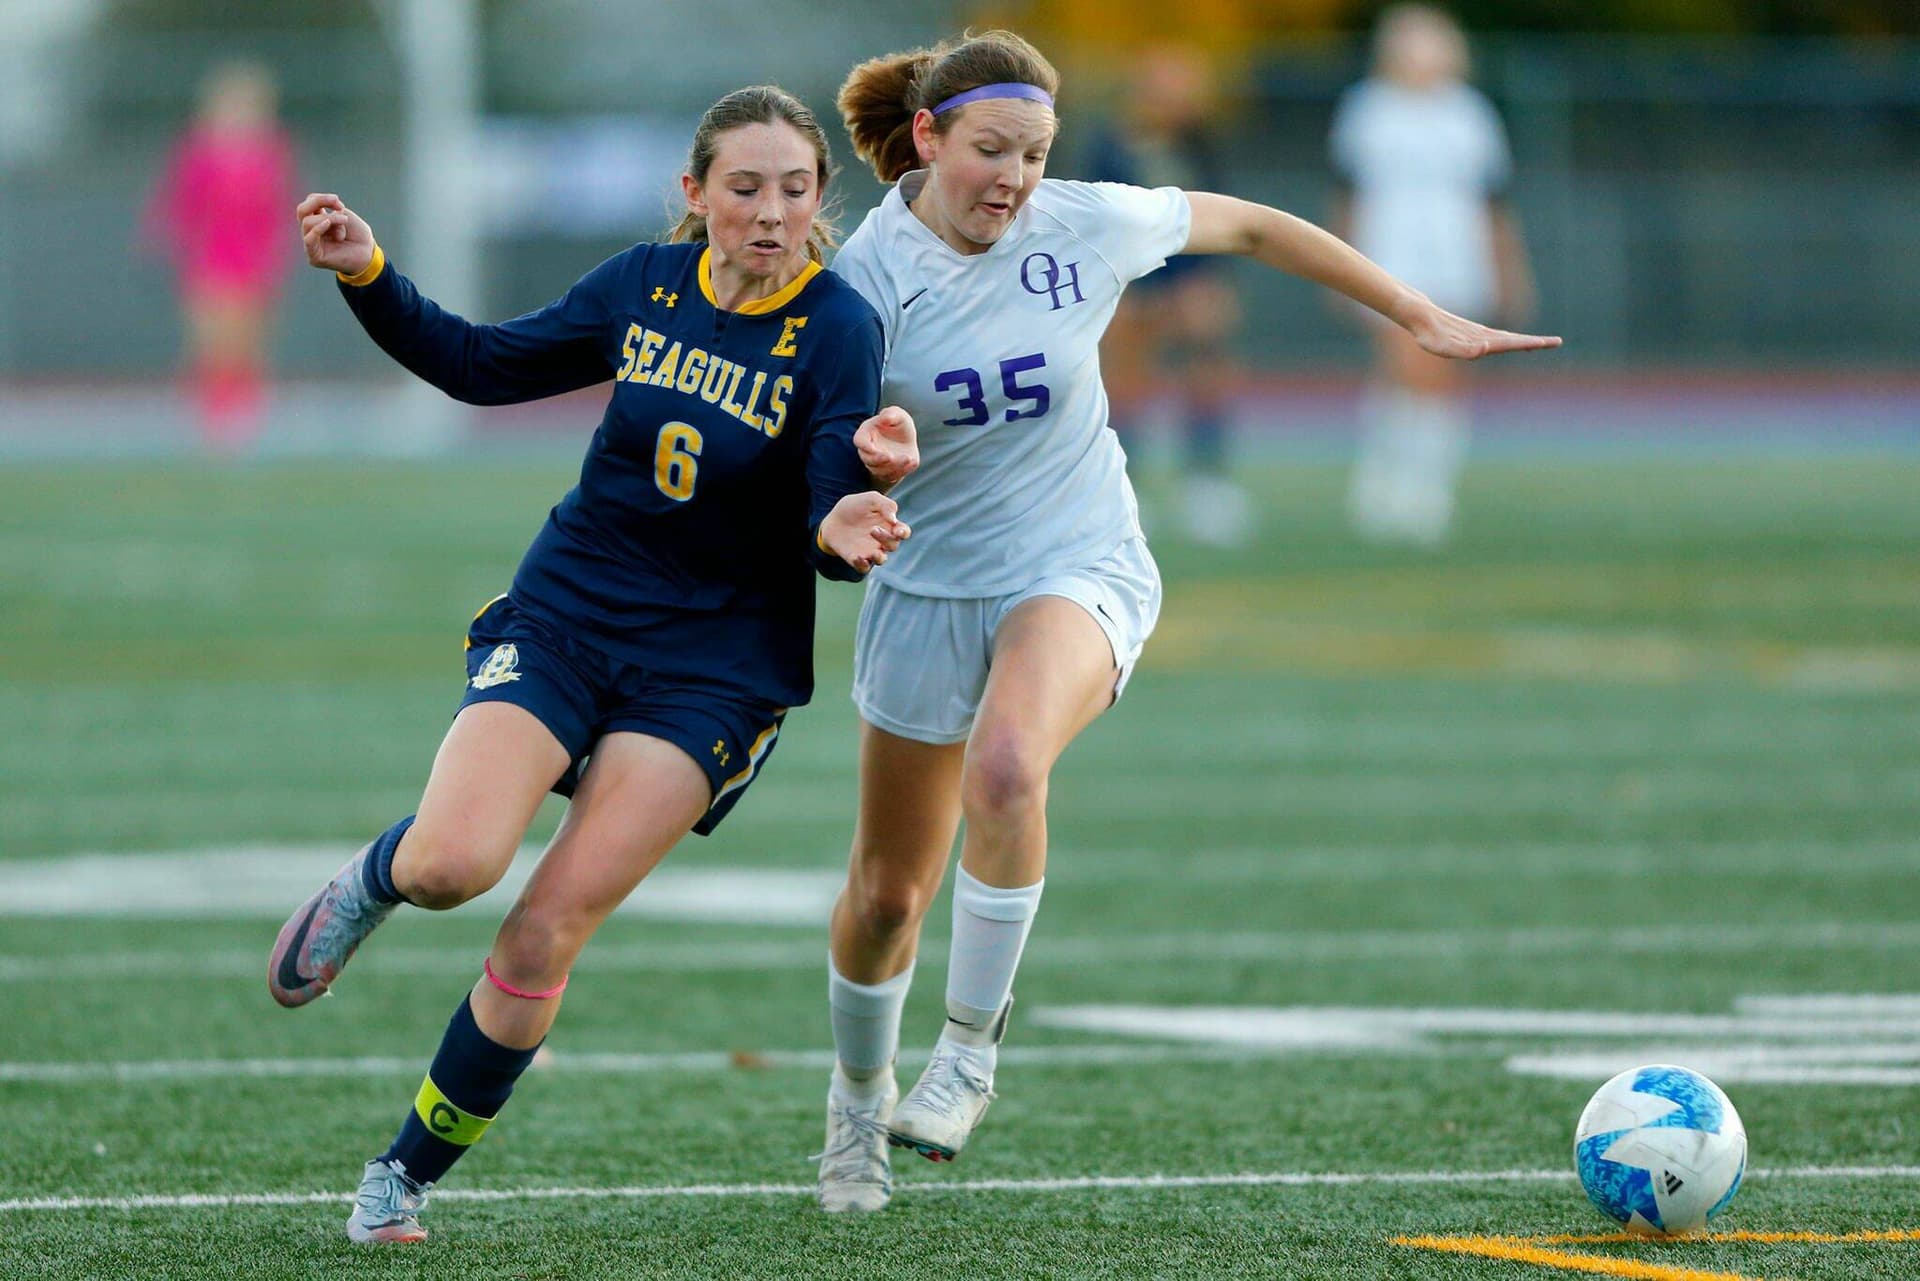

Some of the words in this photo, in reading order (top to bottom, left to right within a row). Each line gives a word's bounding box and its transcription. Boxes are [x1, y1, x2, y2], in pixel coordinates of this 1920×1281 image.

[1020, 252, 1087, 311] OH
[770, 316, 808, 357] E
[616, 322, 794, 438] SEAGULLS
[934, 353, 1050, 426] 35
[655, 421, 703, 501] 6
[430, 1102, 459, 1134] C
